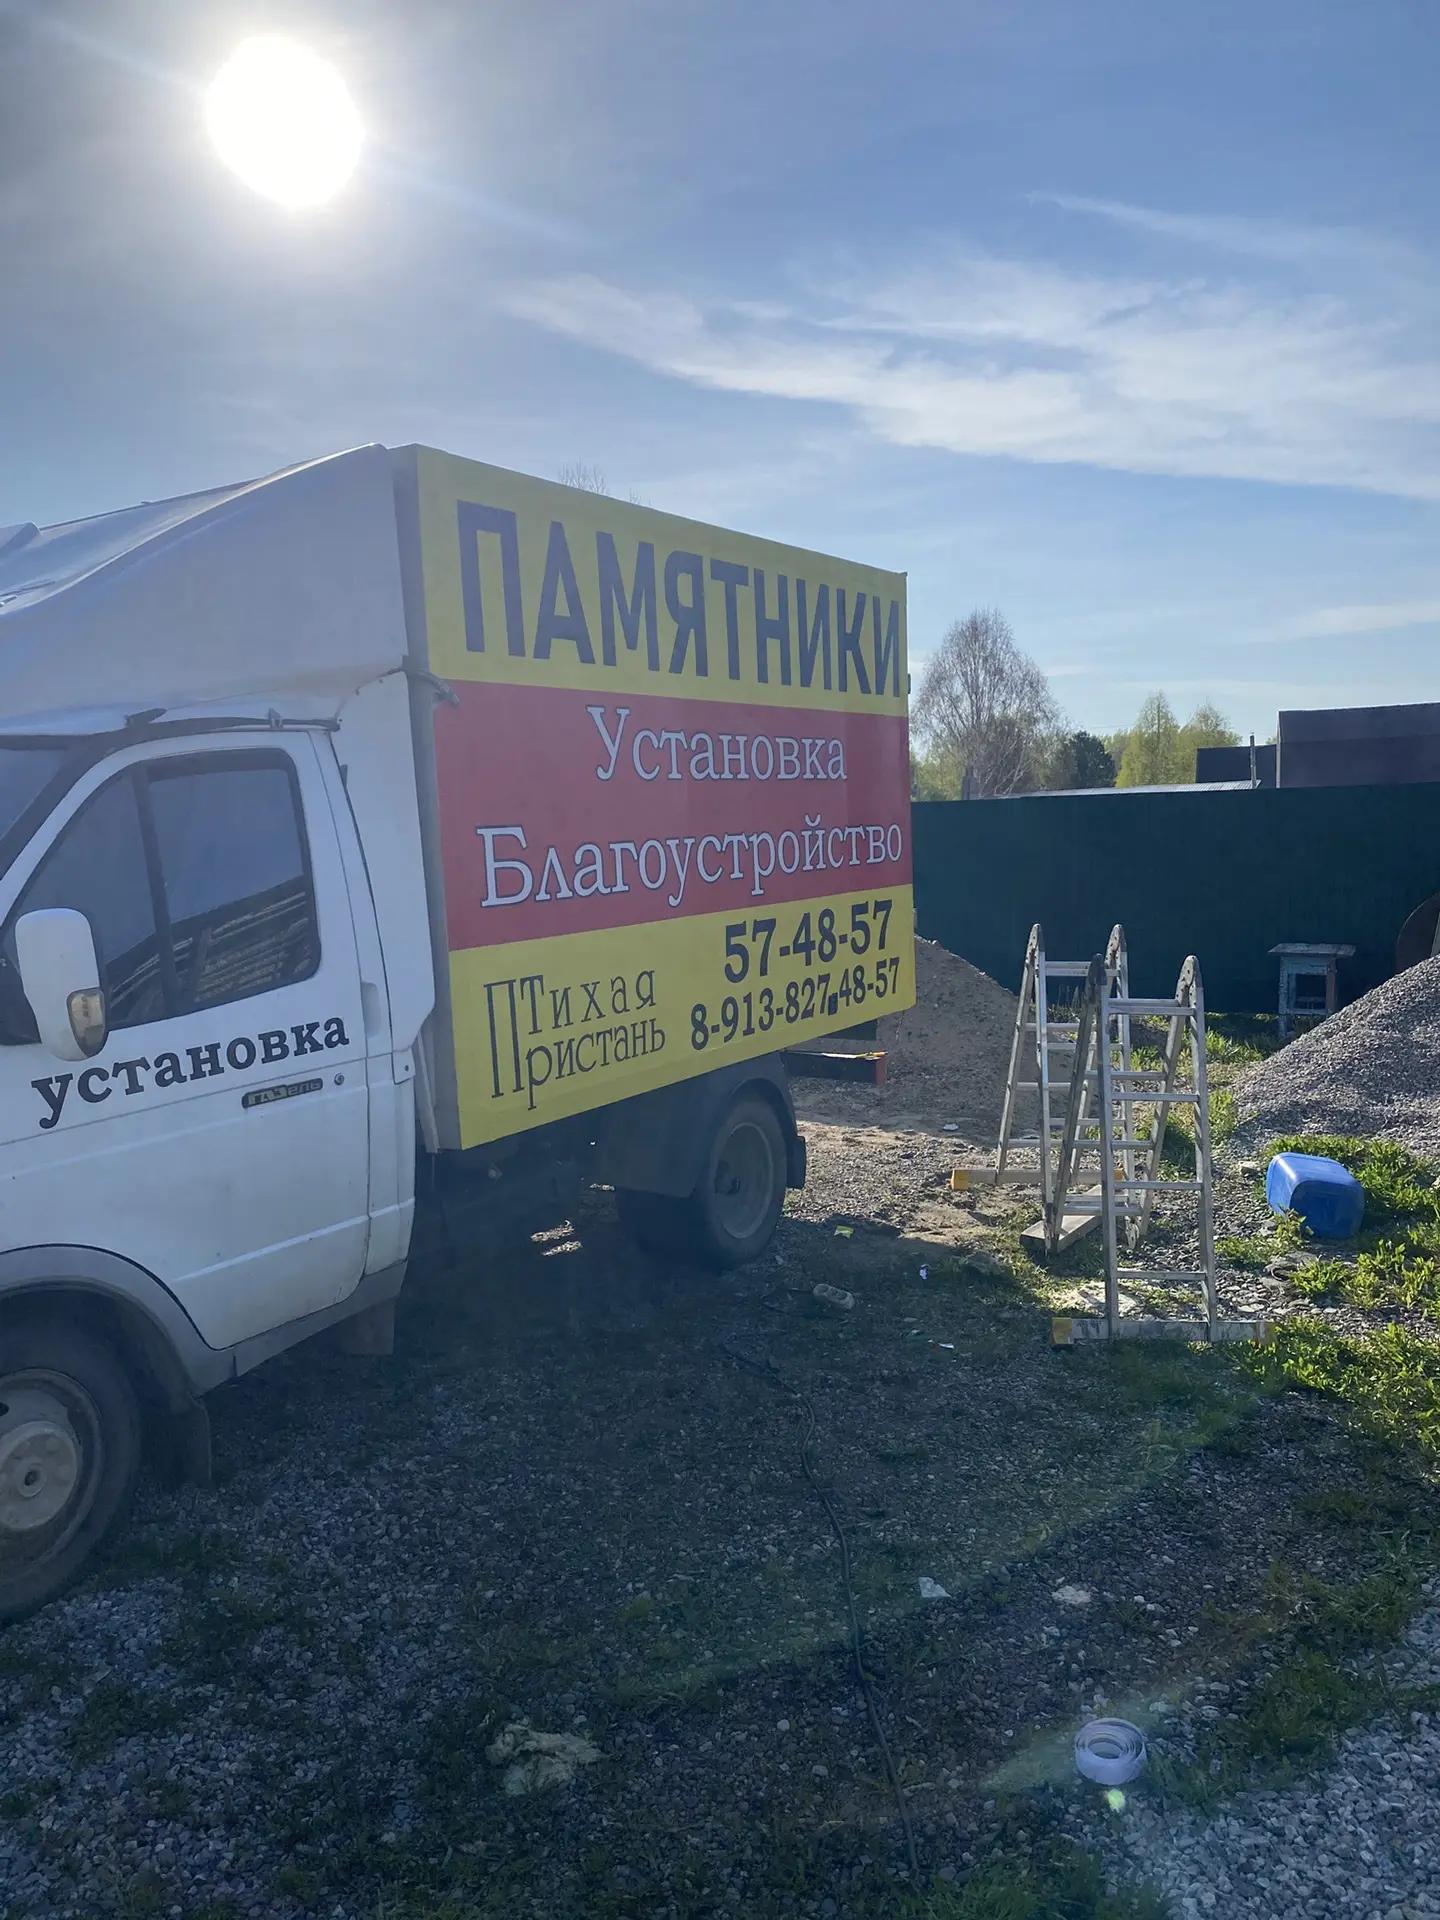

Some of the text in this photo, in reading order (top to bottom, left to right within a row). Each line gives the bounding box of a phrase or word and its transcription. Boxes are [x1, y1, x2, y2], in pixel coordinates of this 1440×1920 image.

[456, 500, 901, 697] ПАМЯТНИКИ
[587, 705, 848, 782] Установка
[475, 814, 903, 908] Благоустройство
[724, 899, 893, 984] 57-48-57
[31, 1016, 350, 1129] установка
